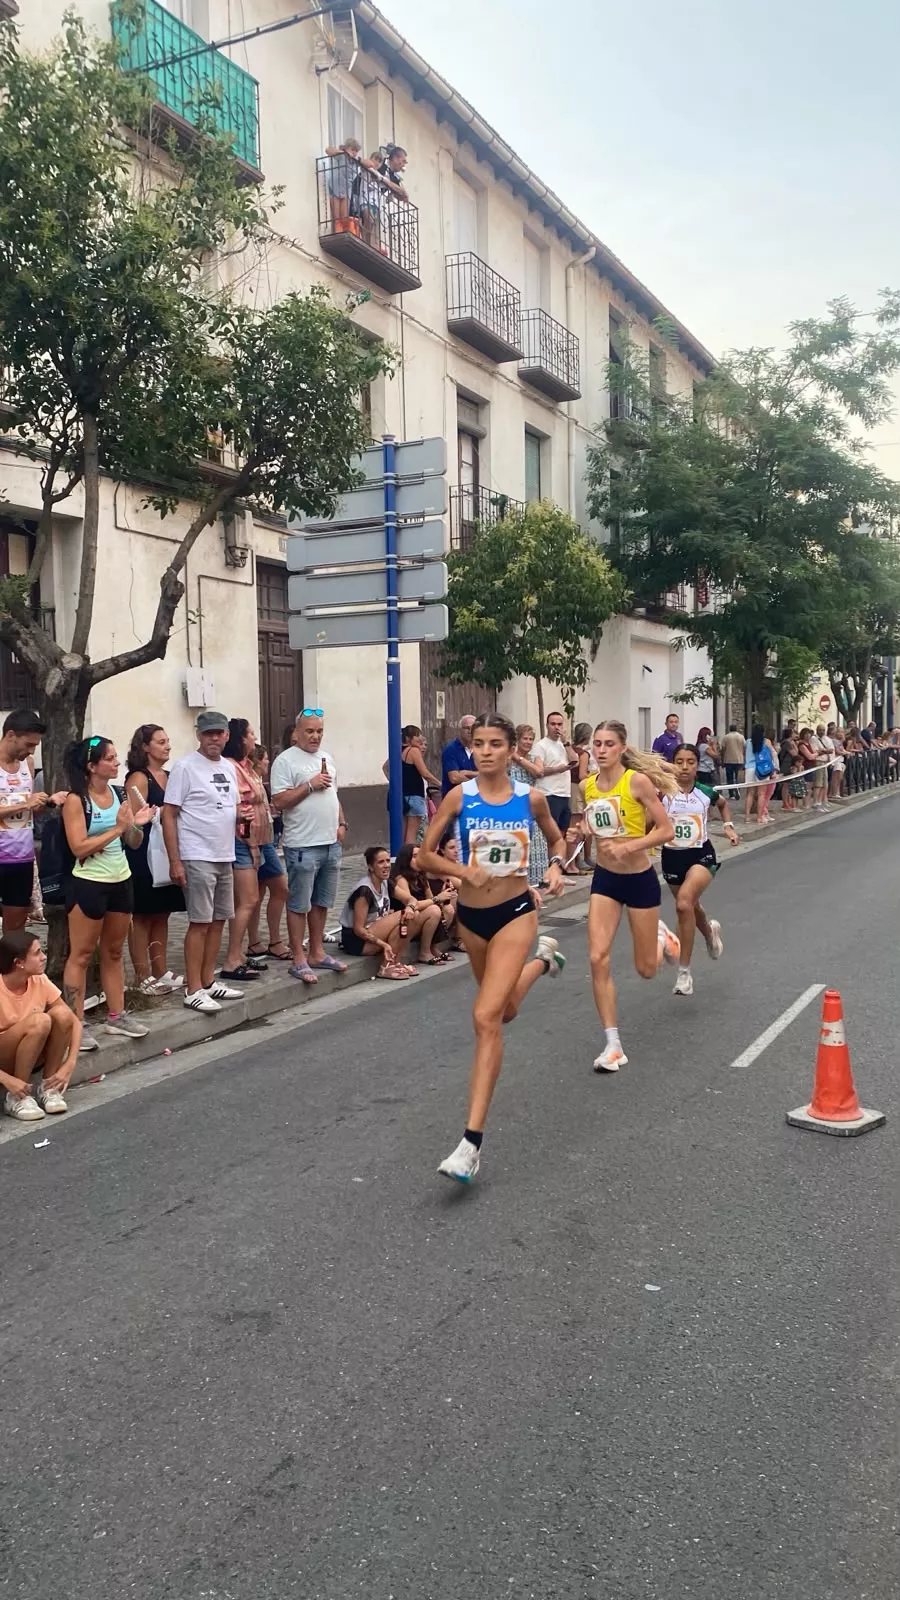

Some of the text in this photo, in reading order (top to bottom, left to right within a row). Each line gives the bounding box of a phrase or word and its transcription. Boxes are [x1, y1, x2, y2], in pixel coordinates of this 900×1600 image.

[595, 812, 611, 827] 80
[675, 826, 692, 838] 93
[489, 847, 511, 864] 81
